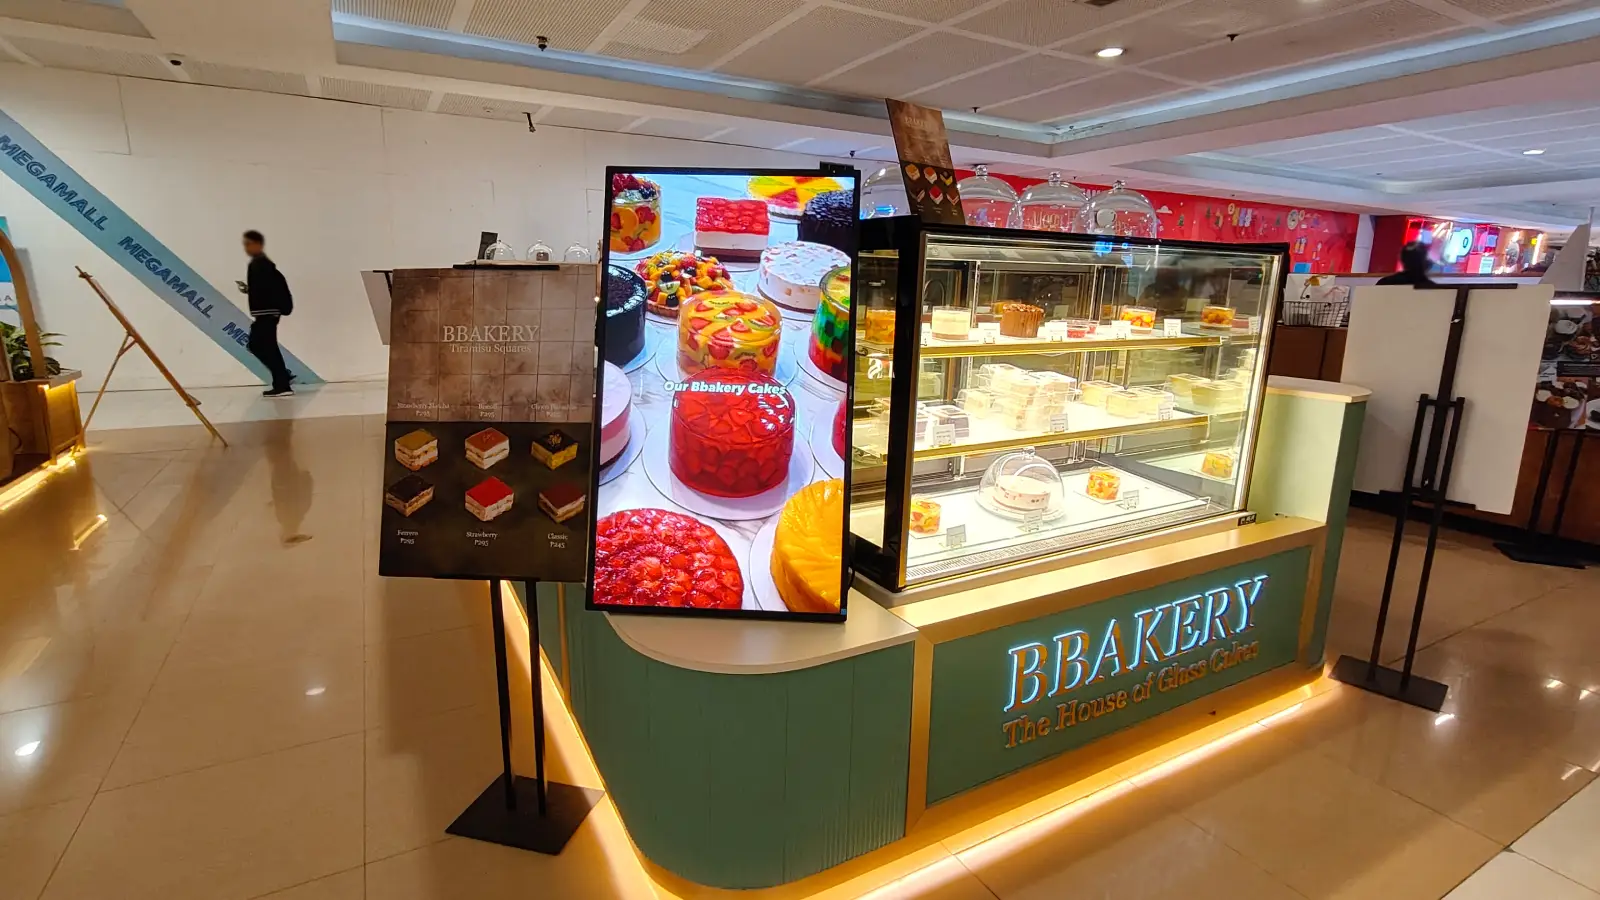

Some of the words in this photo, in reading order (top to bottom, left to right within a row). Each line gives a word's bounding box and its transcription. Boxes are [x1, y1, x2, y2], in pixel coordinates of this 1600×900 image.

[0, 134, 109, 231] MEGAMALL
[117, 236, 213, 319] MEGAMALL
[441, 325, 540, 342] BBAKERY
[450, 343, 491, 353] Tiramisu
[493, 343, 532, 355] Squares
[664, 380, 689, 391] Our
[690, 380, 746, 395] Bbakery
[747, 383, 786, 395] Cakes
[465, 531, 499, 540] Strawberry
[1003, 574, 1270, 713] BBAKERY
[1003, 715, 1050, 748] The
[1054, 690, 1128, 732] House
[1132, 671, 1155, 703] of
[1157, 659, 1208, 692] Glass
[1210, 641, 1260, 673] Cakes
